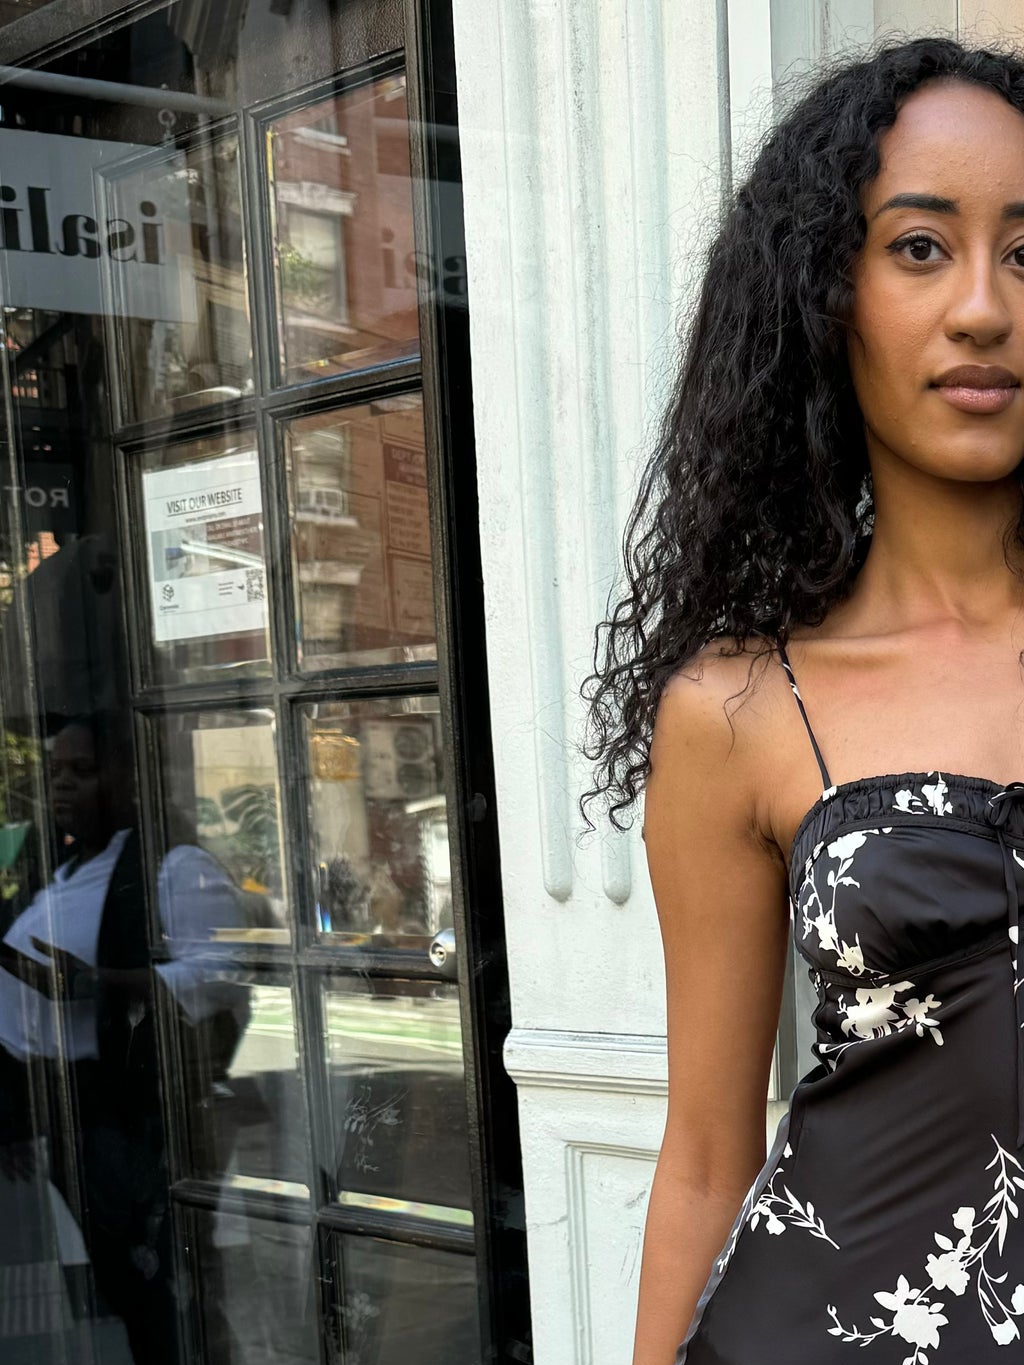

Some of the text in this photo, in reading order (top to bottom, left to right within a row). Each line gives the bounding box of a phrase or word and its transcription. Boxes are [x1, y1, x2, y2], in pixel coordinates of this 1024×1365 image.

[166, 487, 243, 514] VISIT OUR WEBSITE
